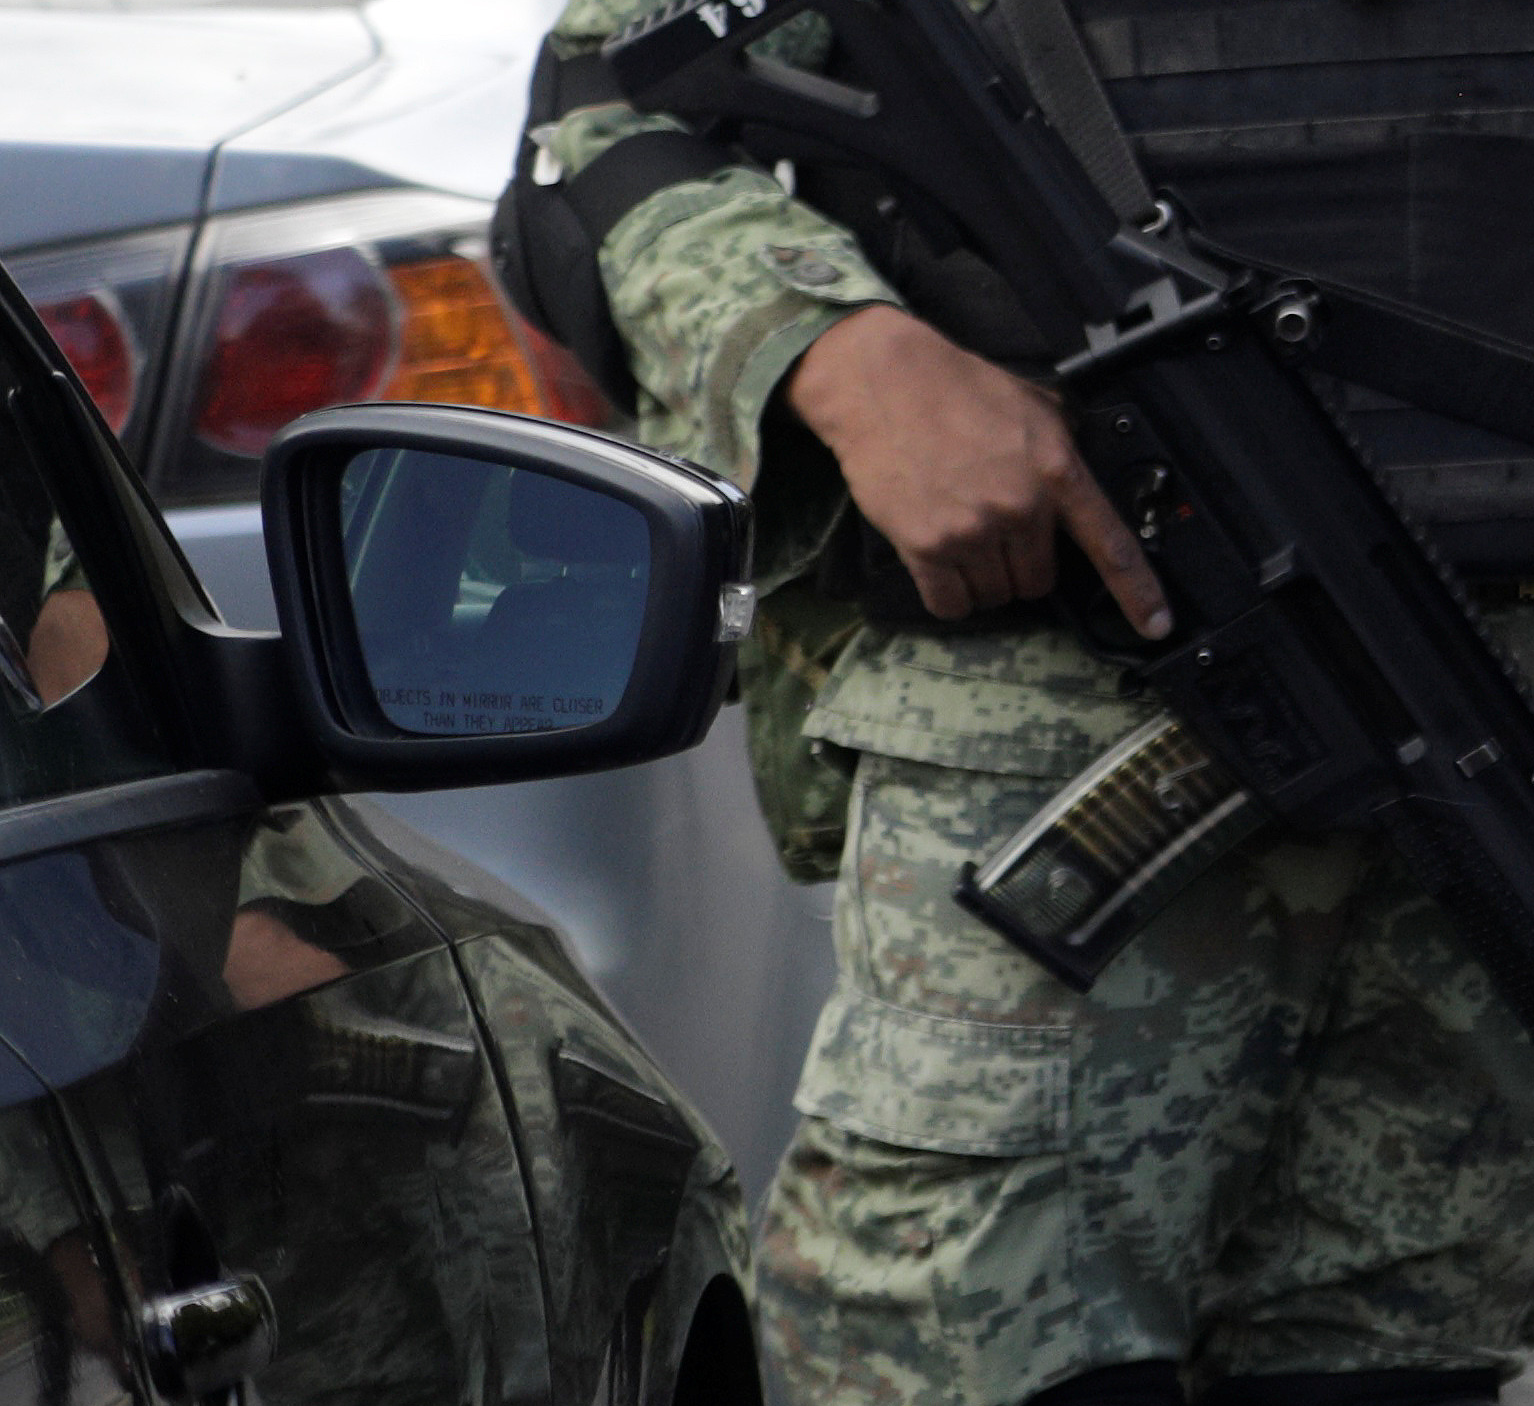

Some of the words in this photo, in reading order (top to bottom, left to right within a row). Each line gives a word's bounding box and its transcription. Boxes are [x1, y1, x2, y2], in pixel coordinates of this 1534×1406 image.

[440, 691, 456, 708] IN
[463, 692, 512, 712] MIRROR
[521, 695, 544, 713] ARE
[552, 697, 604, 715] CLOSER
[423, 711, 456, 728] THAN
[464, 713, 497, 732] THEY
